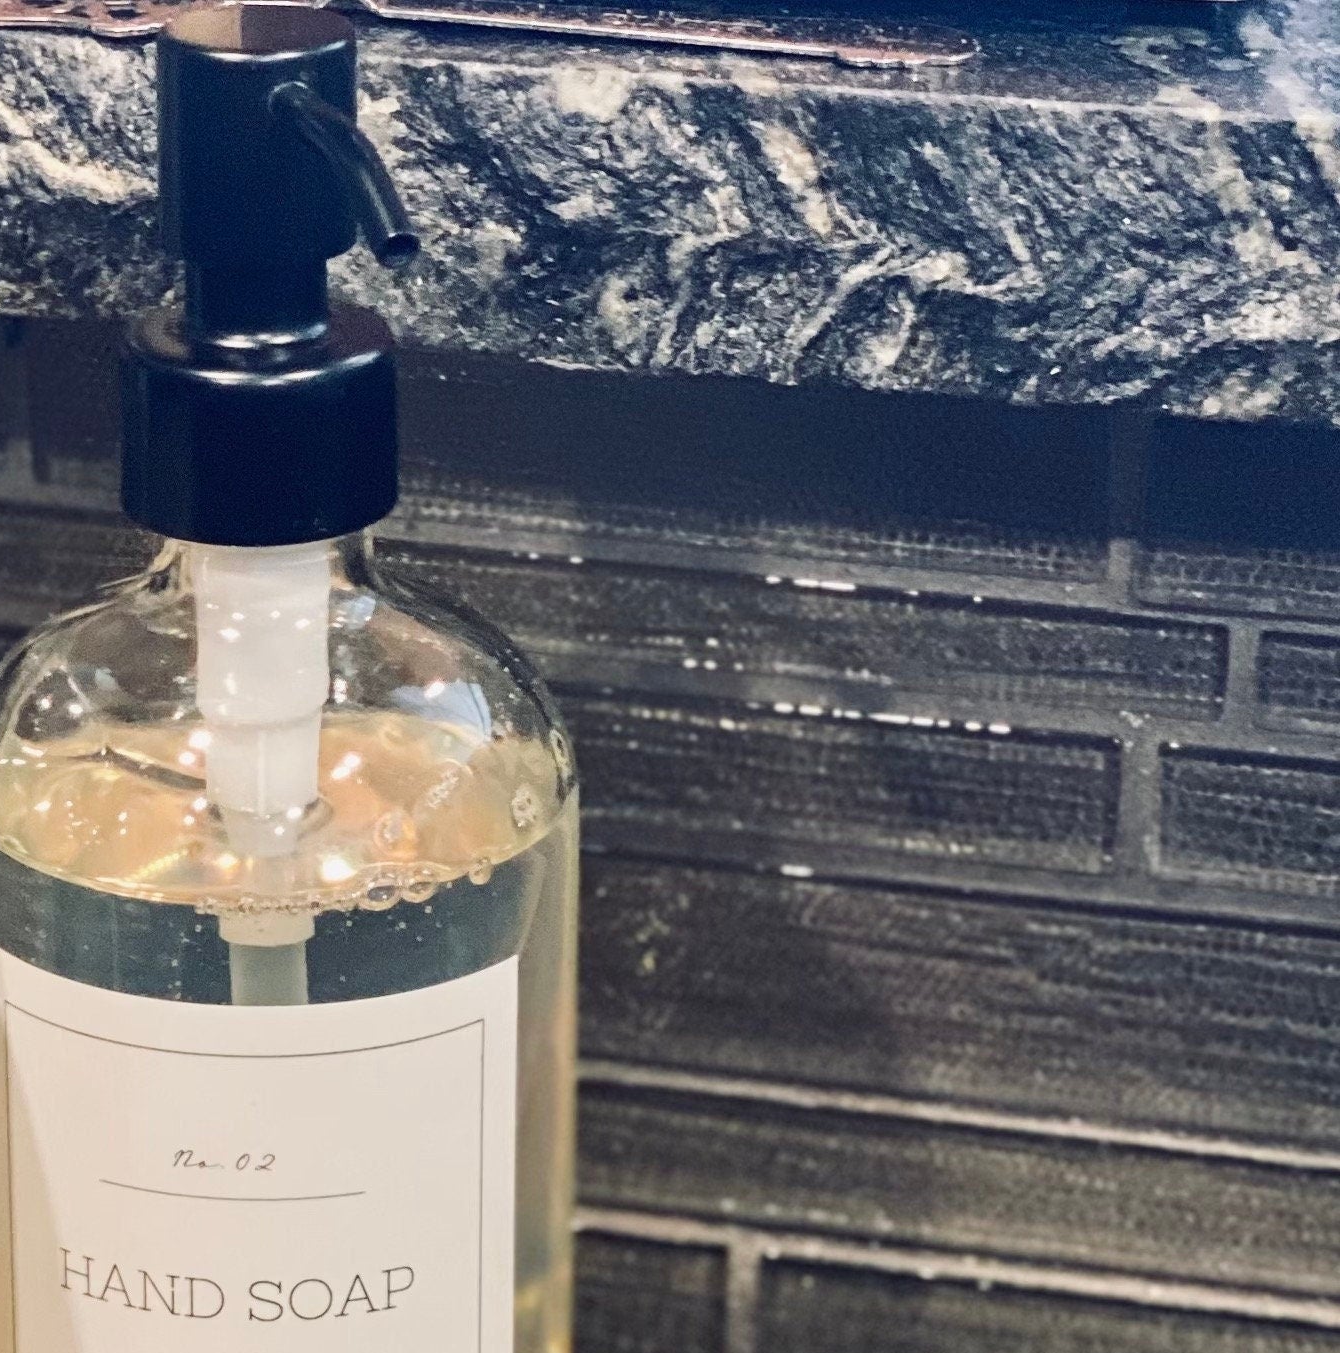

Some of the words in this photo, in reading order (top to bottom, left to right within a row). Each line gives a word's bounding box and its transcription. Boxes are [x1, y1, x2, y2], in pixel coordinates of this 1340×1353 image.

[235, 1152, 276, 1172] 02
[59, 1247, 226, 1321] HAND
[247, 1265, 416, 1323] SOAP
